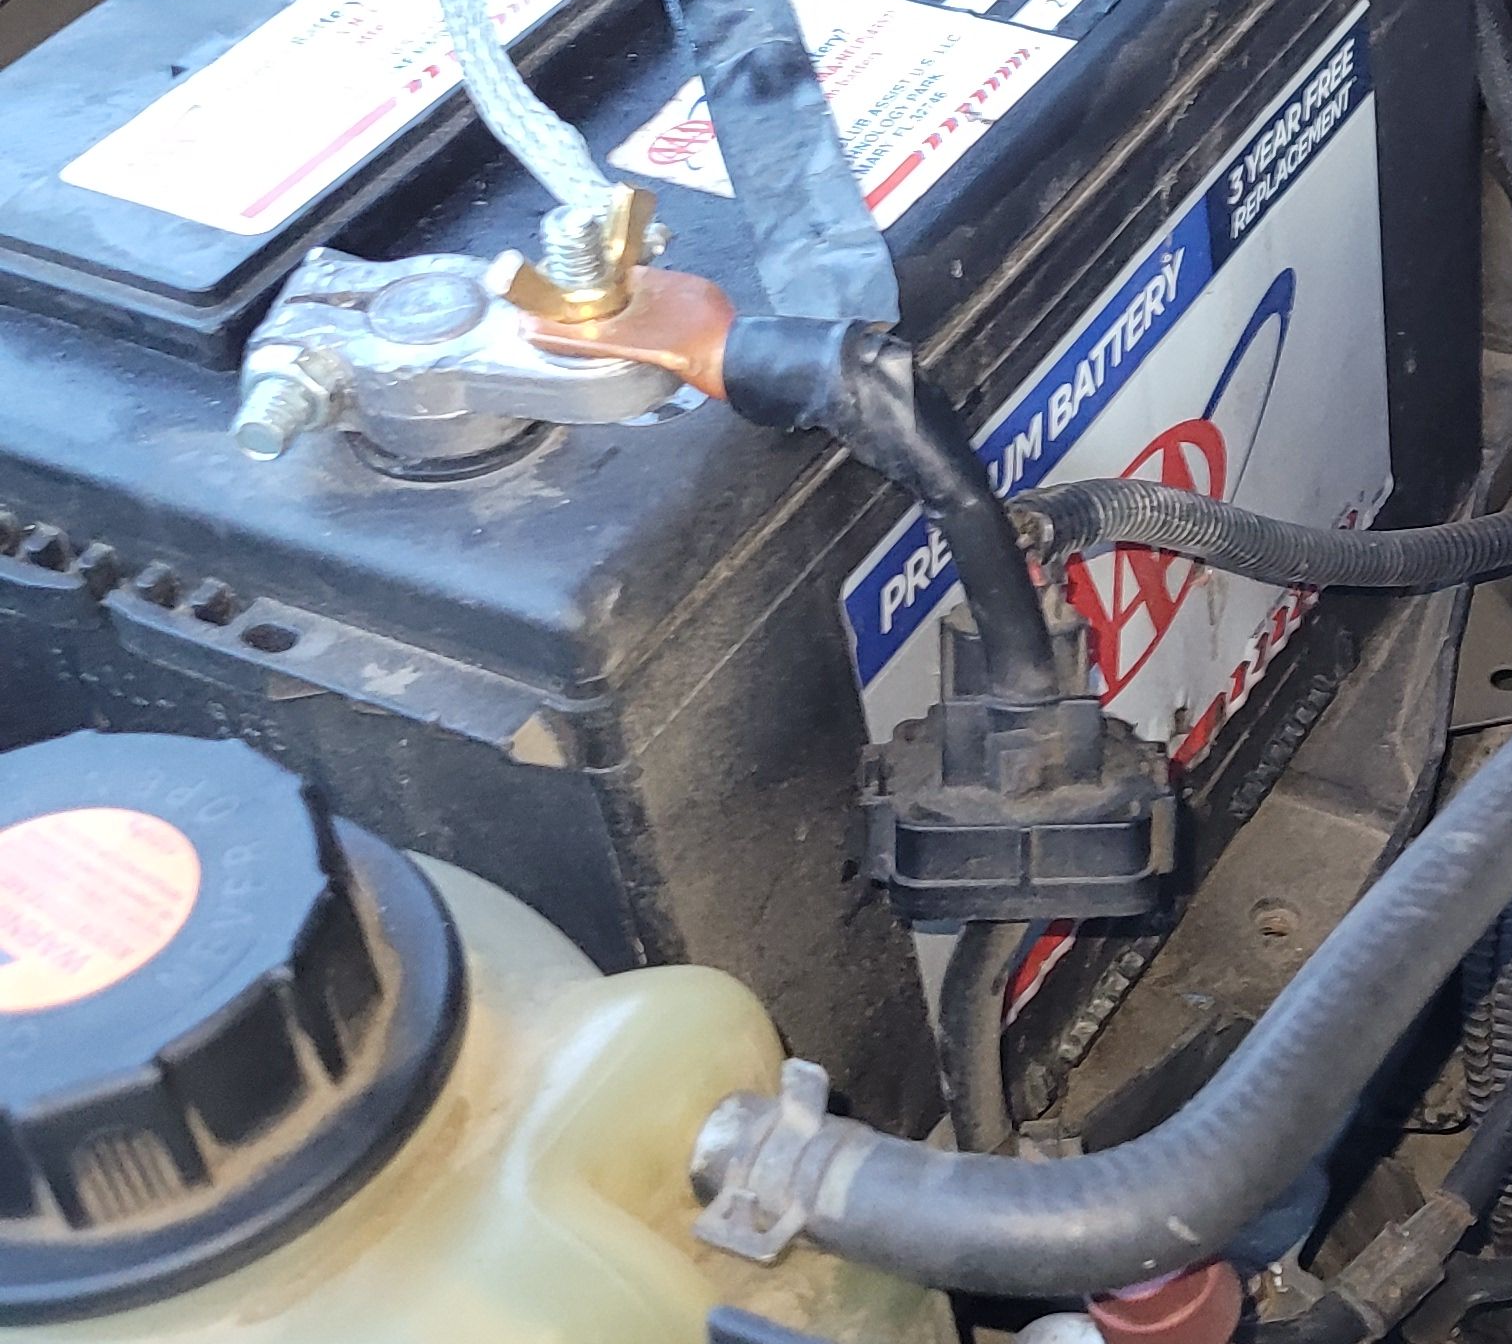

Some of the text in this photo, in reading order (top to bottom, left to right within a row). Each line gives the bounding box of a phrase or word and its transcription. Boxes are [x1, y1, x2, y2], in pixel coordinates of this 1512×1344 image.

[1226, 37, 1356, 205] 3 YEAR FREE
[1230, 77, 1356, 240] REPLACEMENT
[1045, 246, 1187, 444] BATTERY
